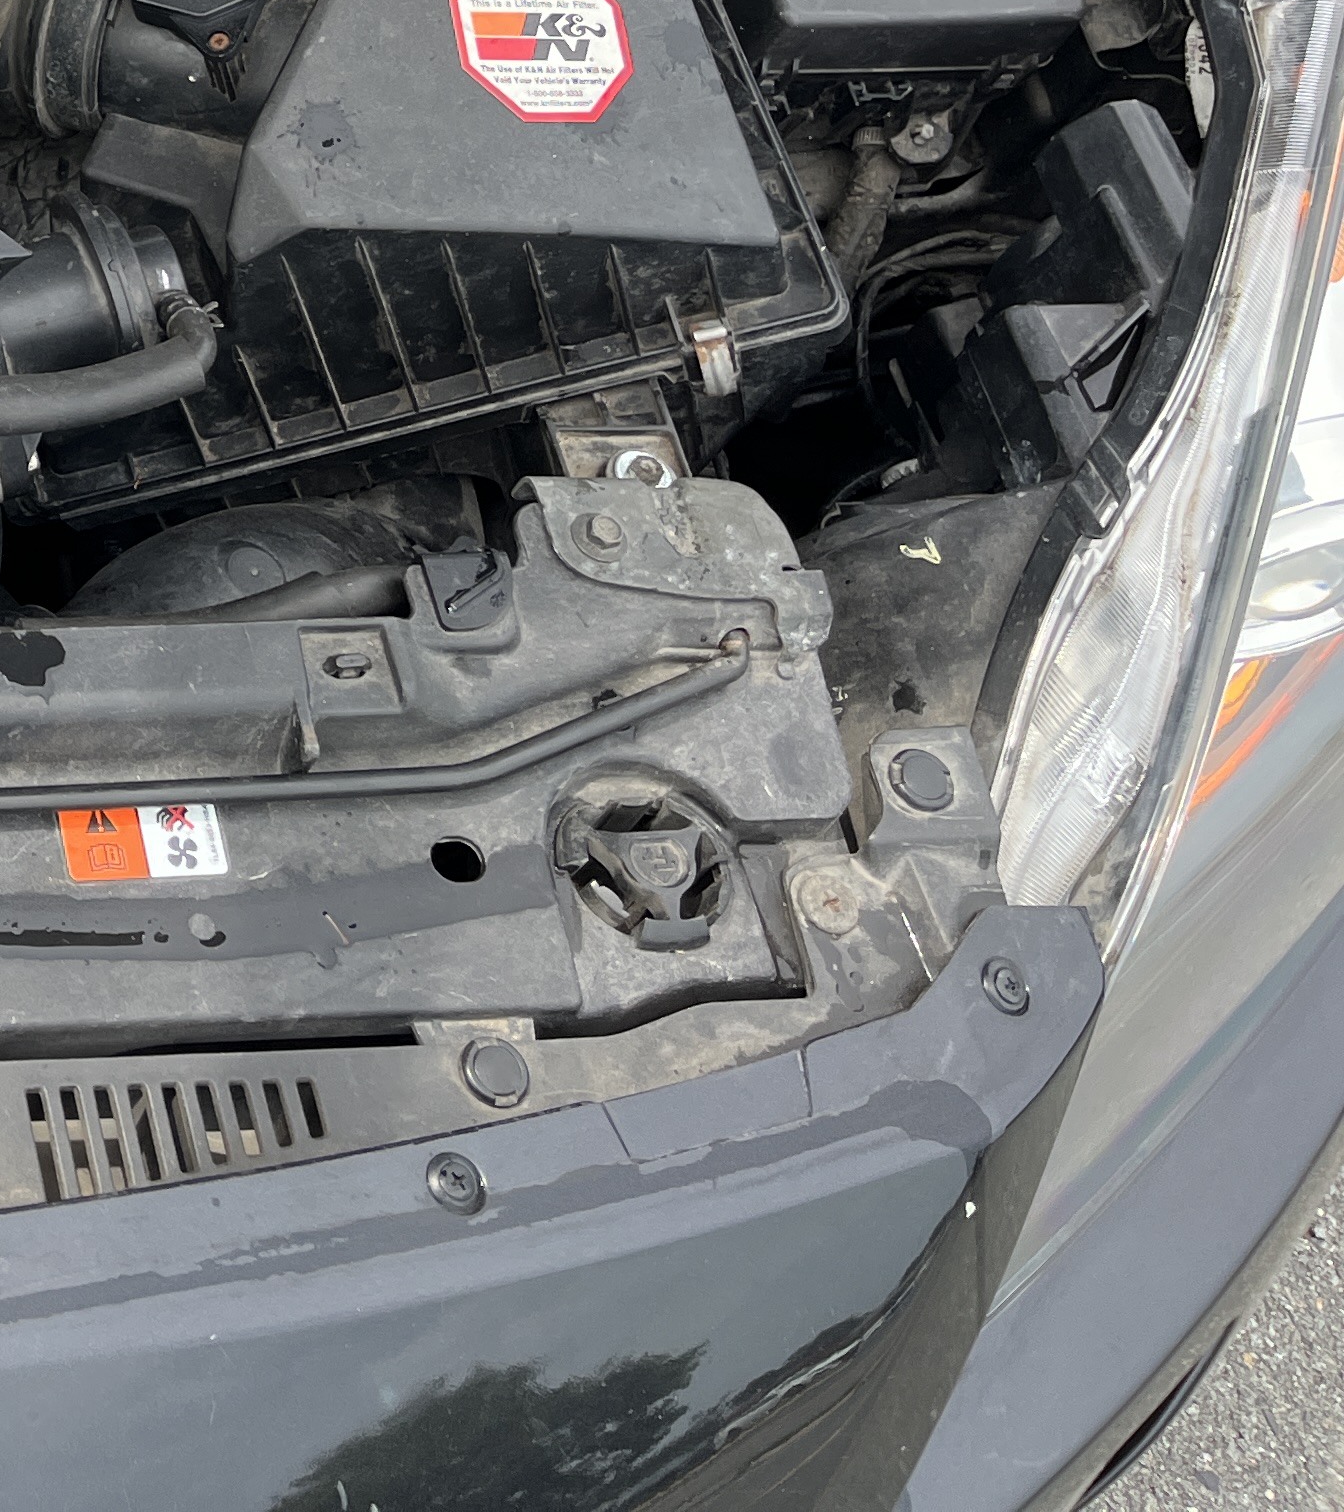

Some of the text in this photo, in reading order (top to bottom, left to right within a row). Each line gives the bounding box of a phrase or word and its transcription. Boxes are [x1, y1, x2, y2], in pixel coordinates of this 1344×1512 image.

[470, 0, 490, 8] This
[494, 0, 502, 8] is
[515, 0, 552, 9] Lifetime
[556, 0, 569, 9] Air
[573, 1, 599, 10] Filter.
[498, 65, 512, 73] Use
[514, 76, 532, 84] Your
[572, 77, 606, 87] Warranty
